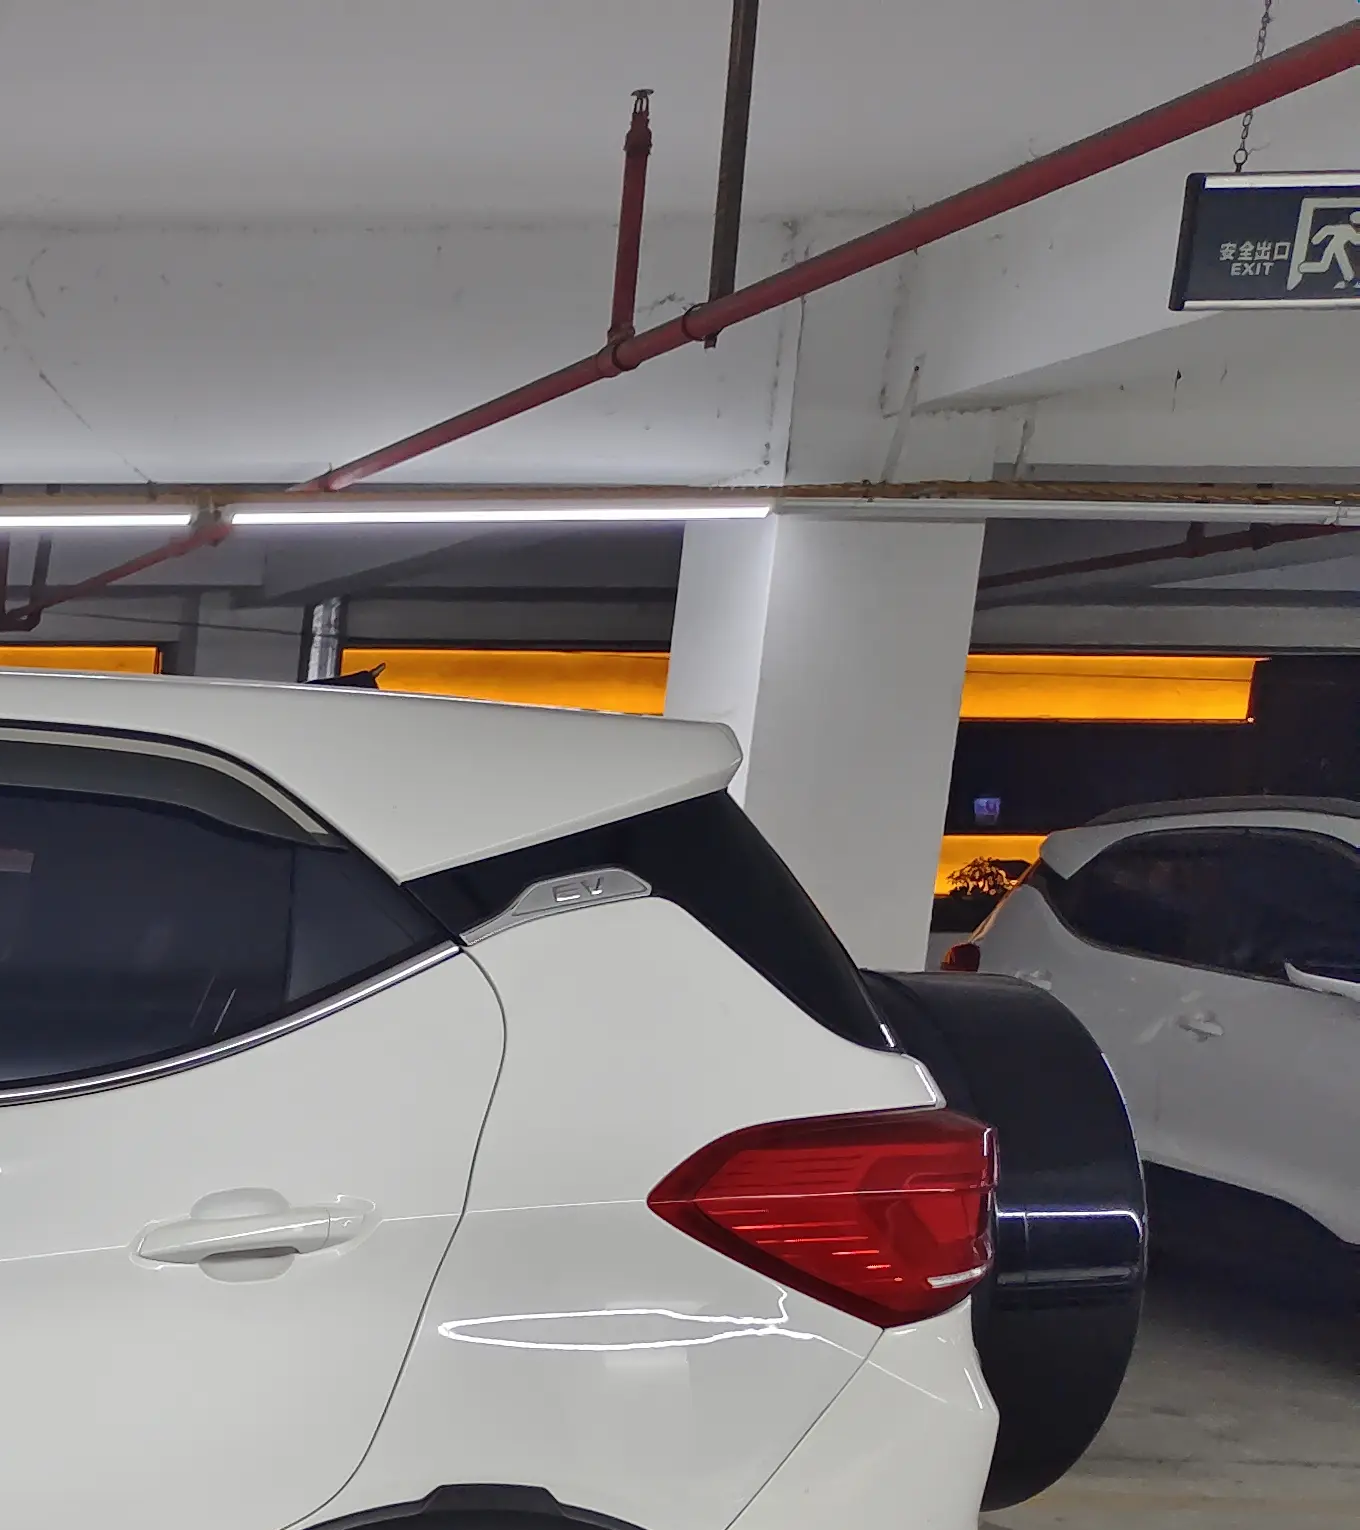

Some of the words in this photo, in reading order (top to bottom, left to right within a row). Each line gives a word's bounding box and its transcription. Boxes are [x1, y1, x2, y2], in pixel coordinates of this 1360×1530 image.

[1219, 240, 1292, 262] 安全出口
[1230, 261, 1275, 277] EXIT
[552, 876, 604, 902] EV
